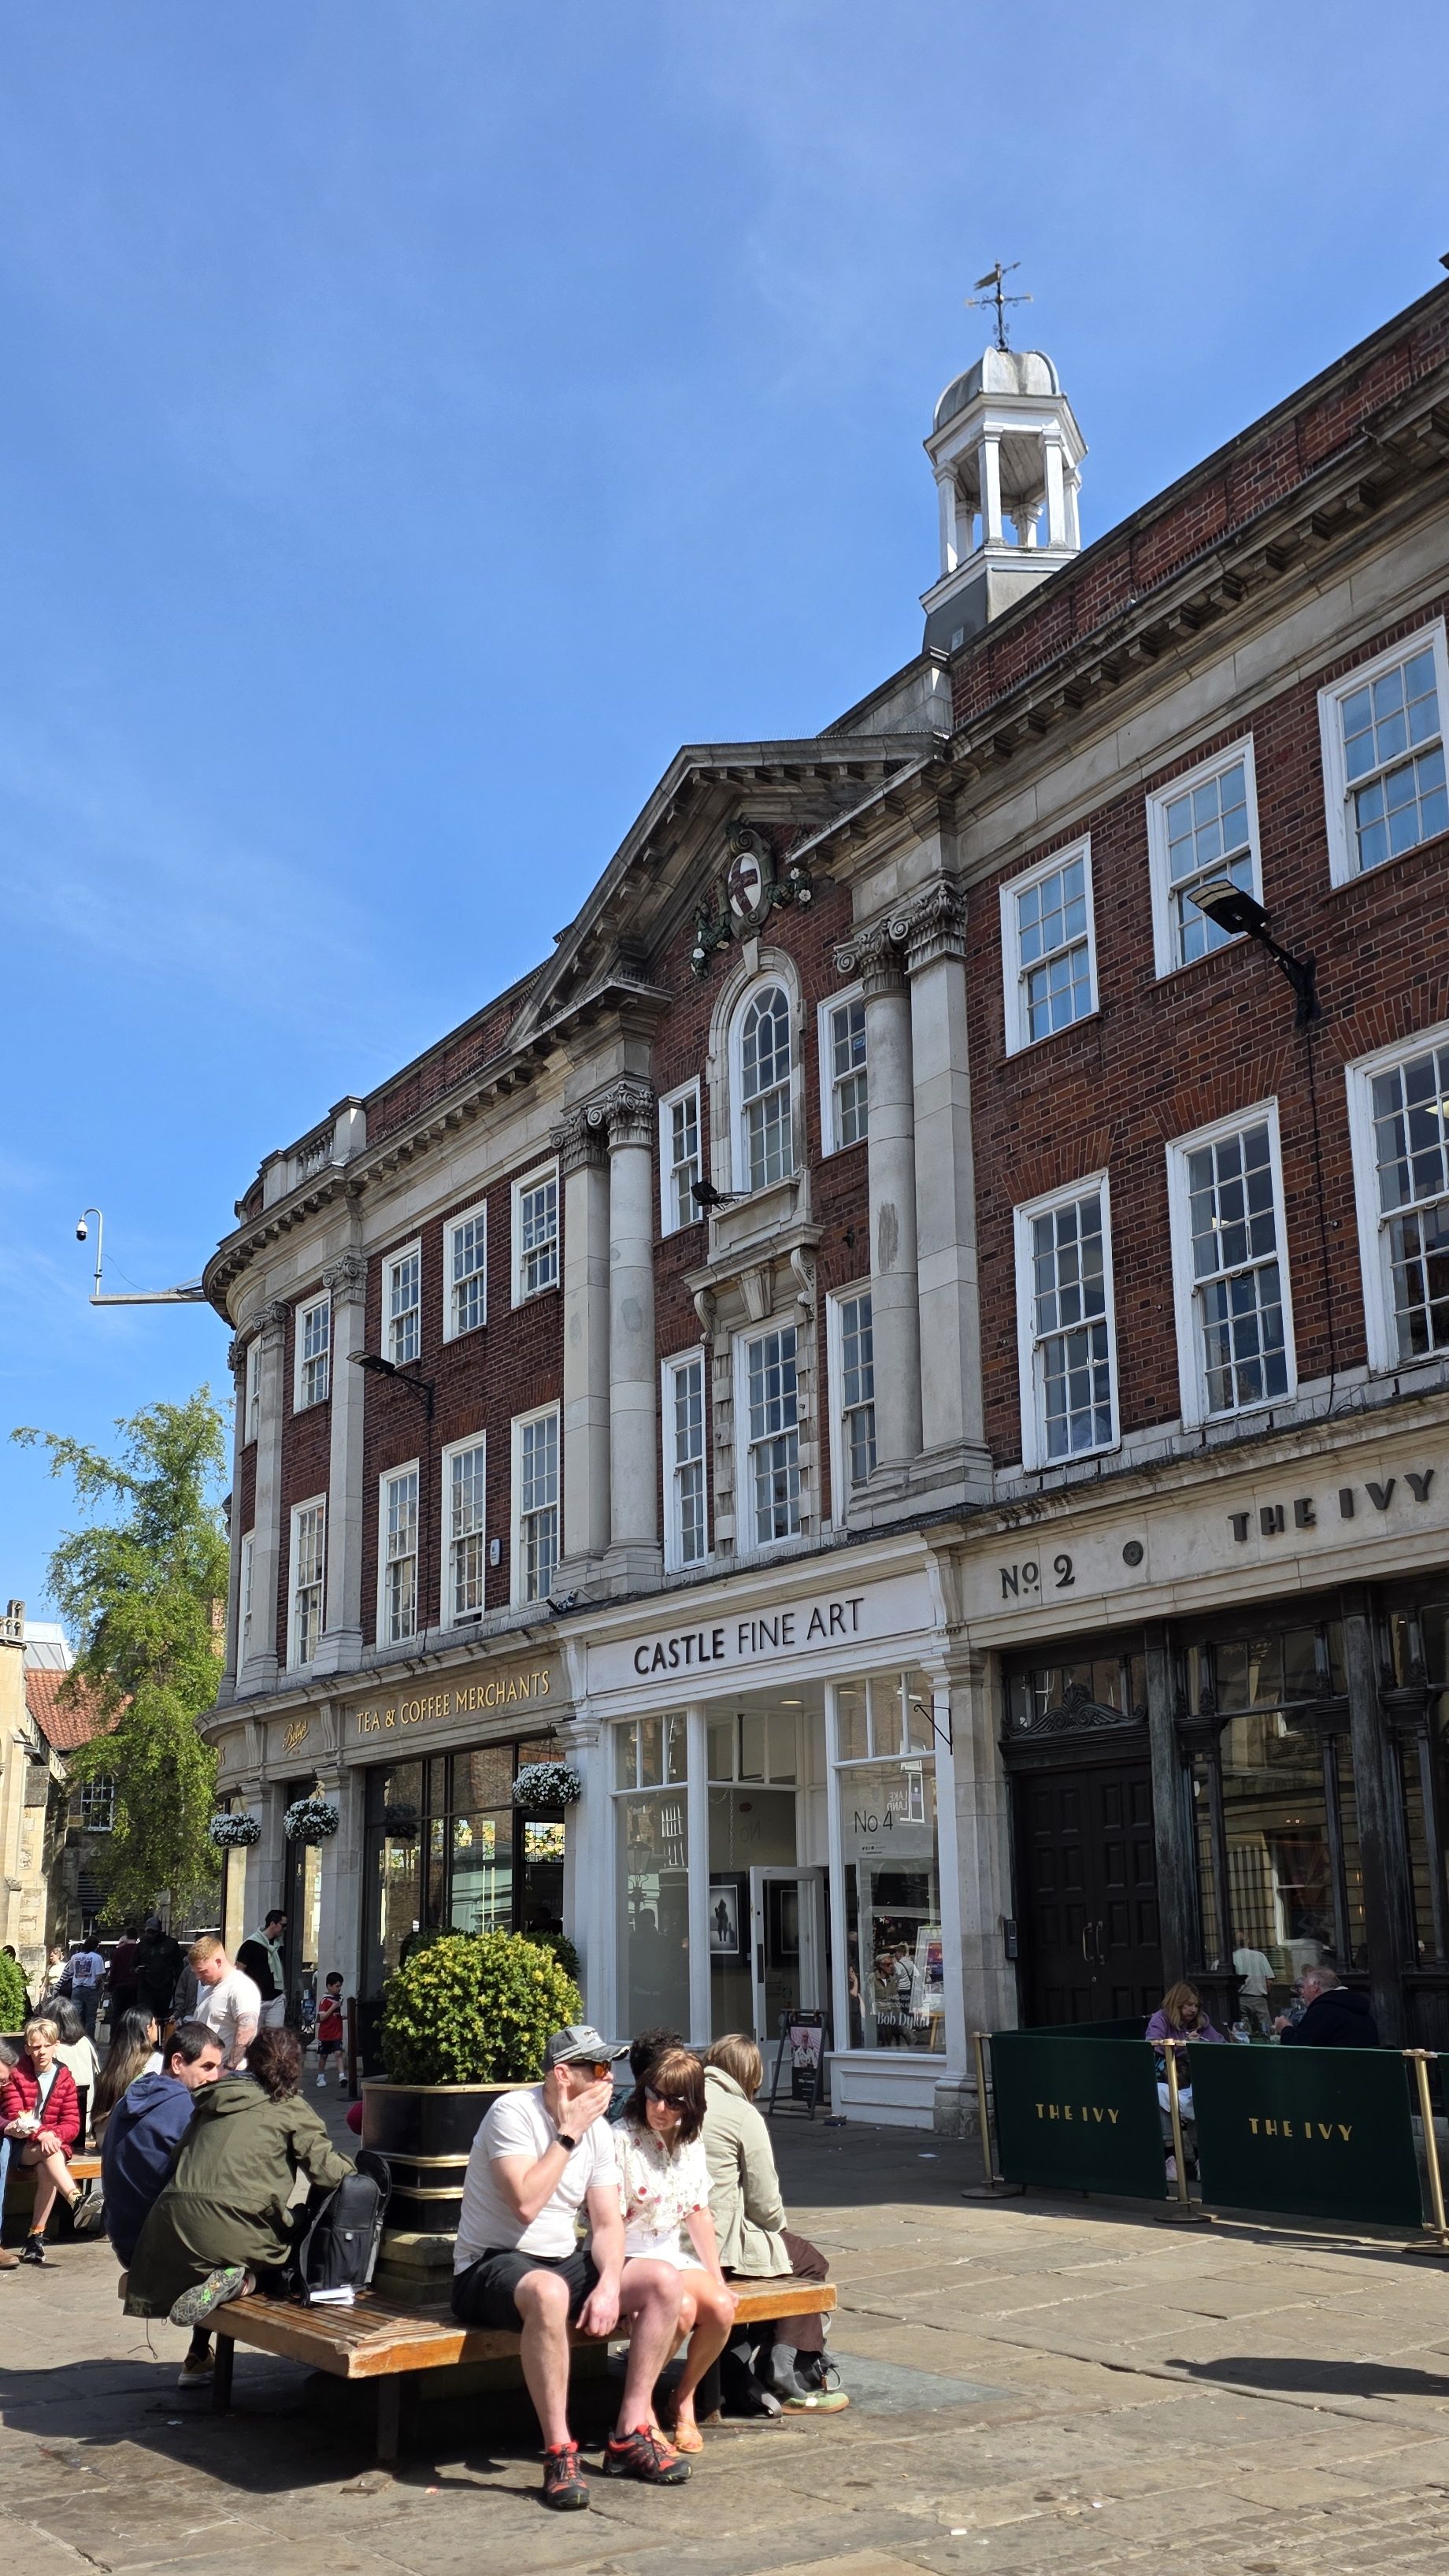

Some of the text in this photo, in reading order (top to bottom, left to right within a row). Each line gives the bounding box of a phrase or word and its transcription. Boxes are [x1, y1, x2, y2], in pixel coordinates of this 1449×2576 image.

[1228, 1470, 1435, 1542] THE IVY
[1053, 1554, 1075, 1588] 2
[634, 1597, 864, 1674] CASTLE FINE ART
[357, 1670, 550, 1733] TEA & COFFEE MERCHANTS
[854, 1809, 893, 1833] No 4
[877, 2011, 896, 2026] Bob
[1036, 2103, 1120, 2124] THE IVY
[1249, 2118, 1352, 2141] THE IVY
